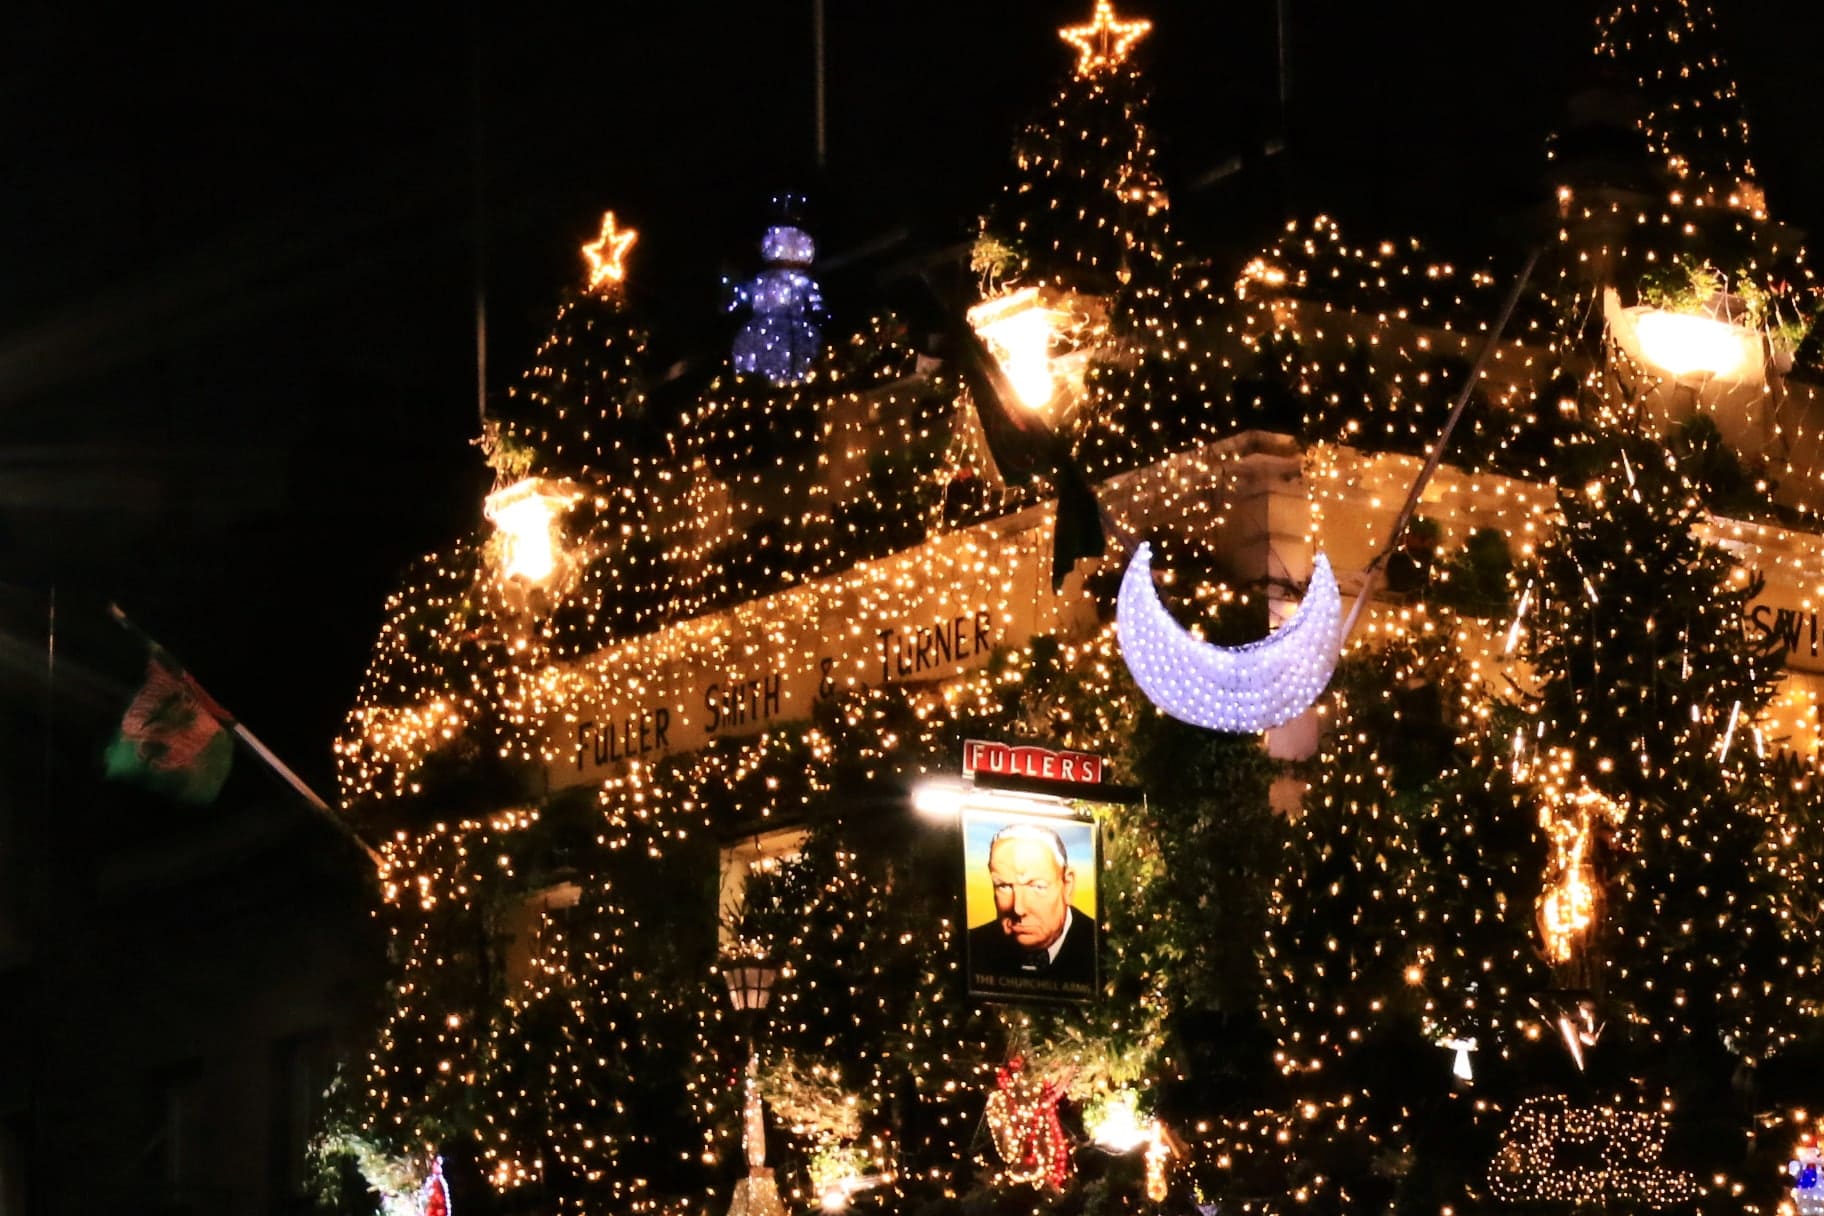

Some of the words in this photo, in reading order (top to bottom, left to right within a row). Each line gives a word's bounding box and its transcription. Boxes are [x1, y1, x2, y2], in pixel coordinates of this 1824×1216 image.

[577, 706, 670, 771] FULLER
[703, 672, 781, 733] SMITH
[819, 656, 838, 699] &
[972, 743, 1094, 783] FULLER'S
[975, 973, 994, 986] THE
